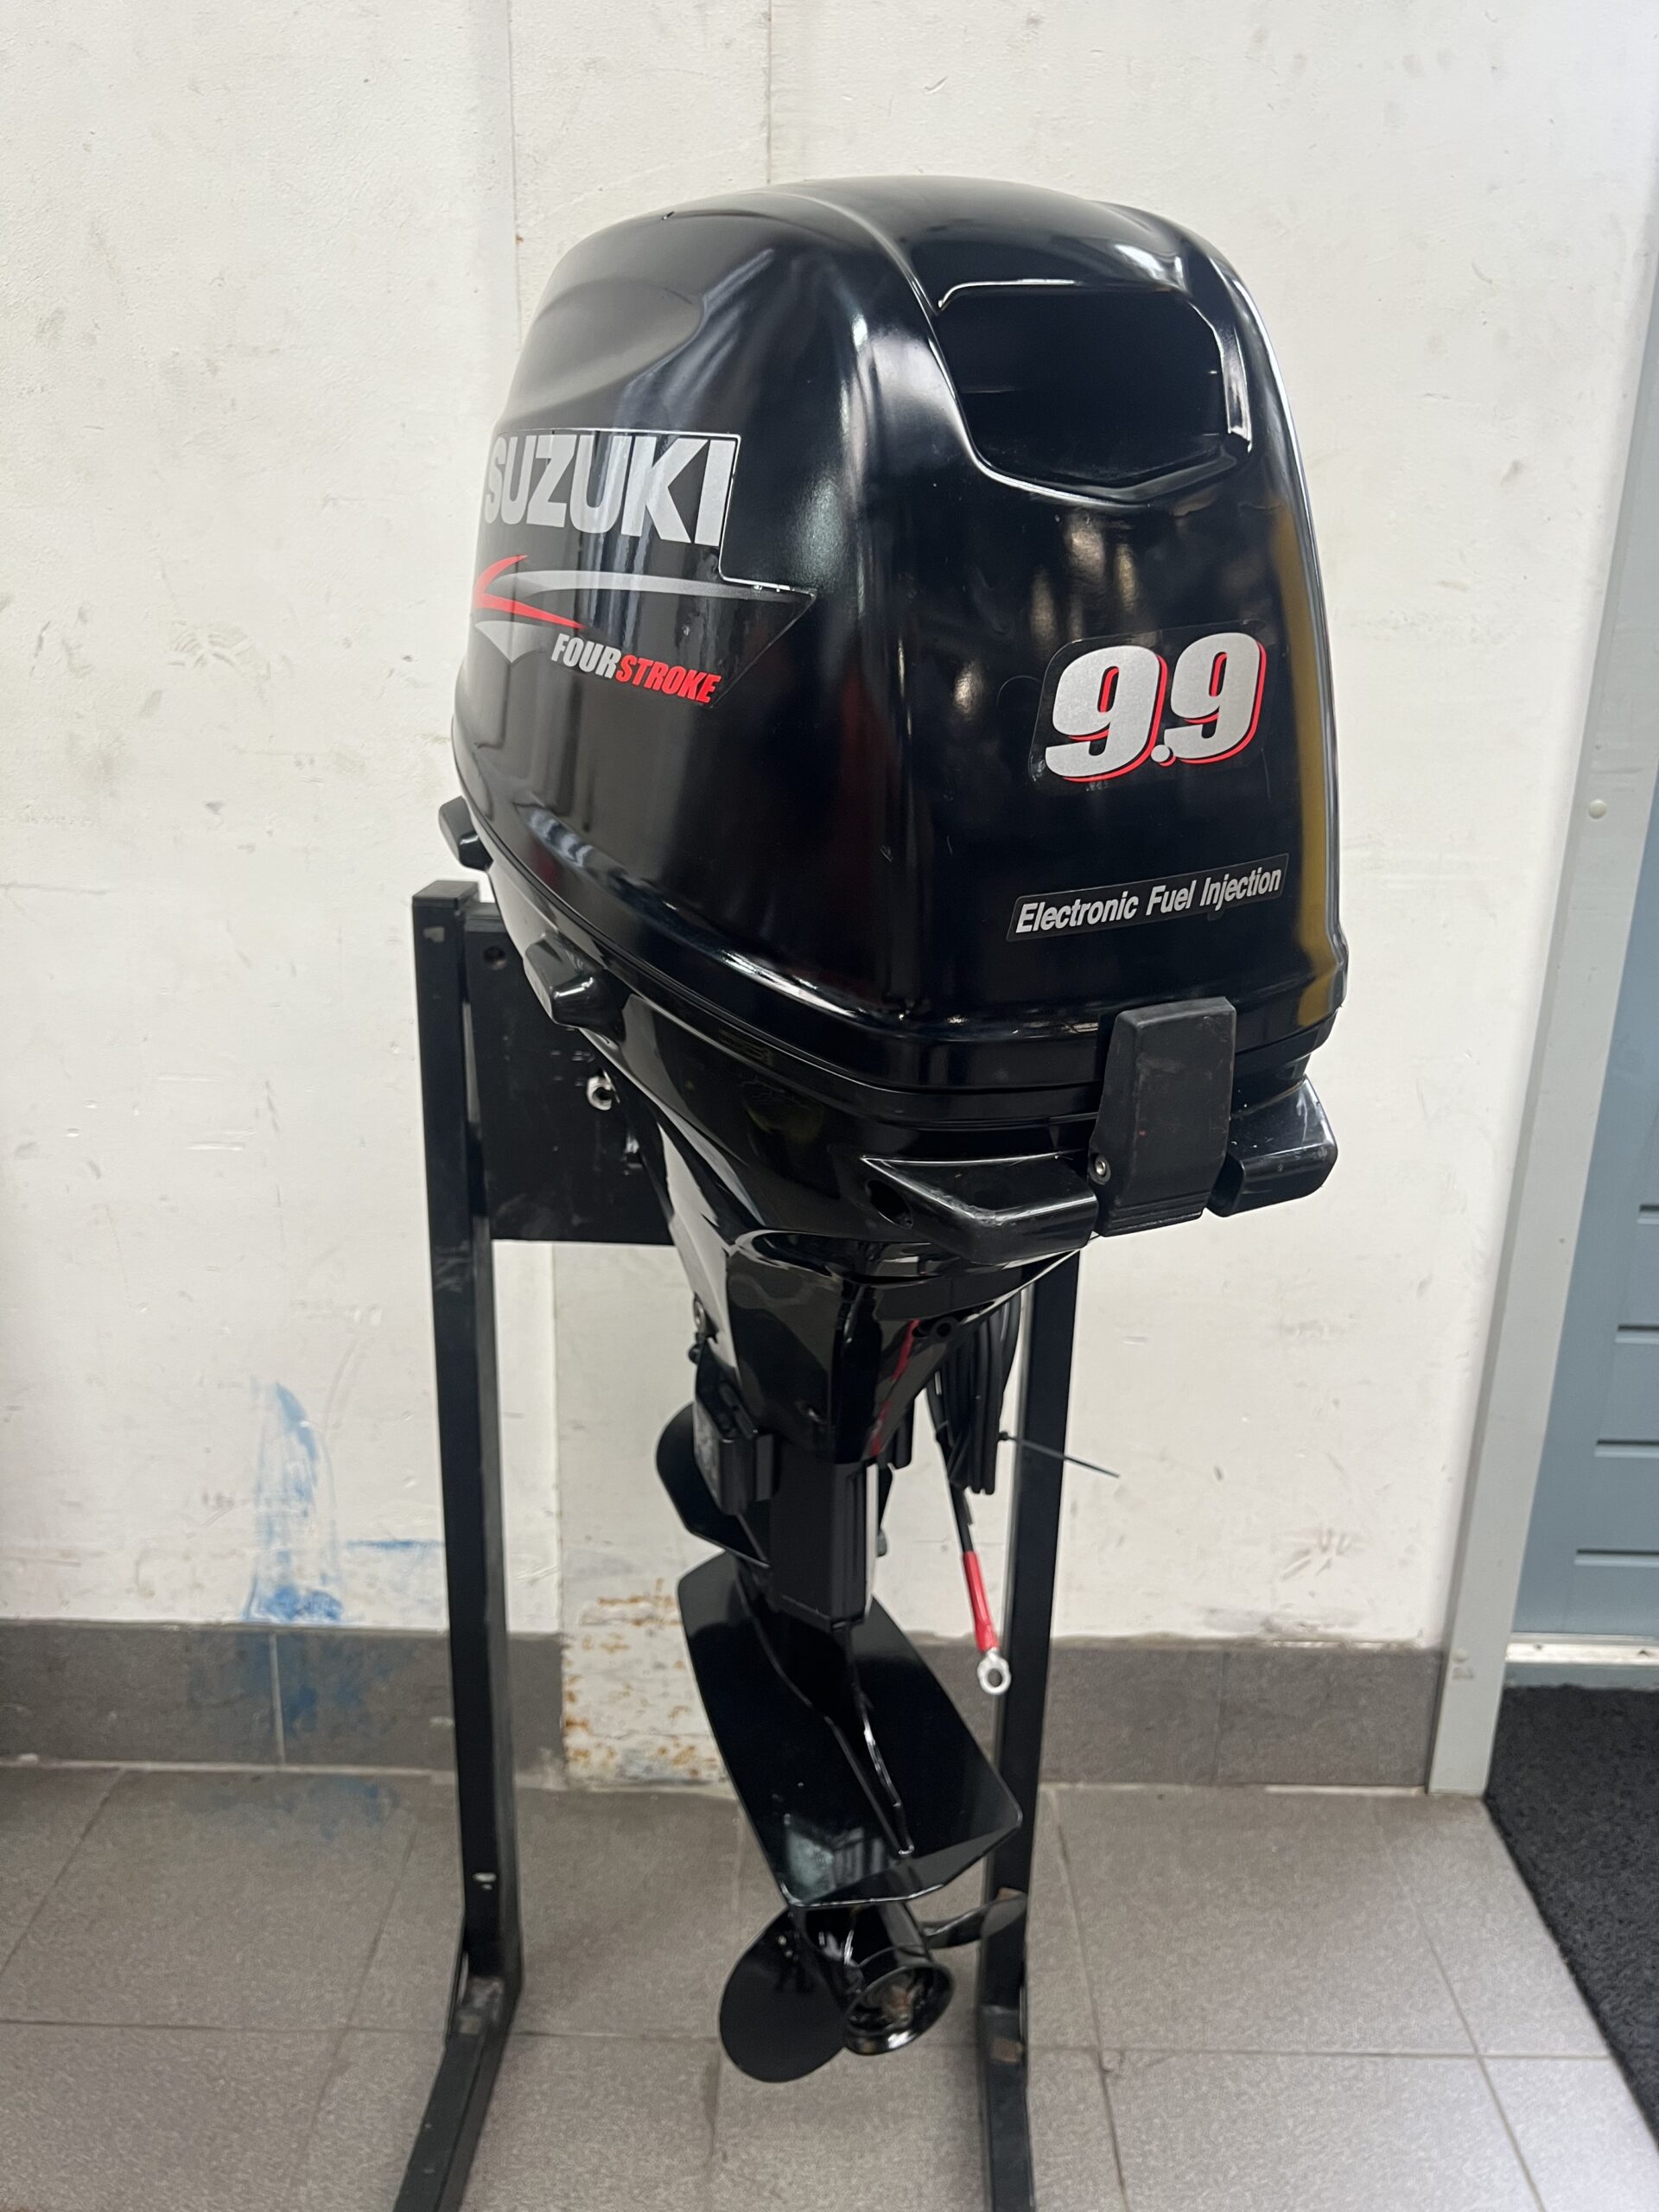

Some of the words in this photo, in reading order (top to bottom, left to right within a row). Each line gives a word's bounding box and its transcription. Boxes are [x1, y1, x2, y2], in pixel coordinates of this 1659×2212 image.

[485, 435, 736, 546] SUZUKI
[1045, 632, 1267, 783] 9.9
[1015, 891, 1139, 934] Electronic
[1146, 880, 1197, 916] Fuel
[1199, 867, 1281, 912] Injection
